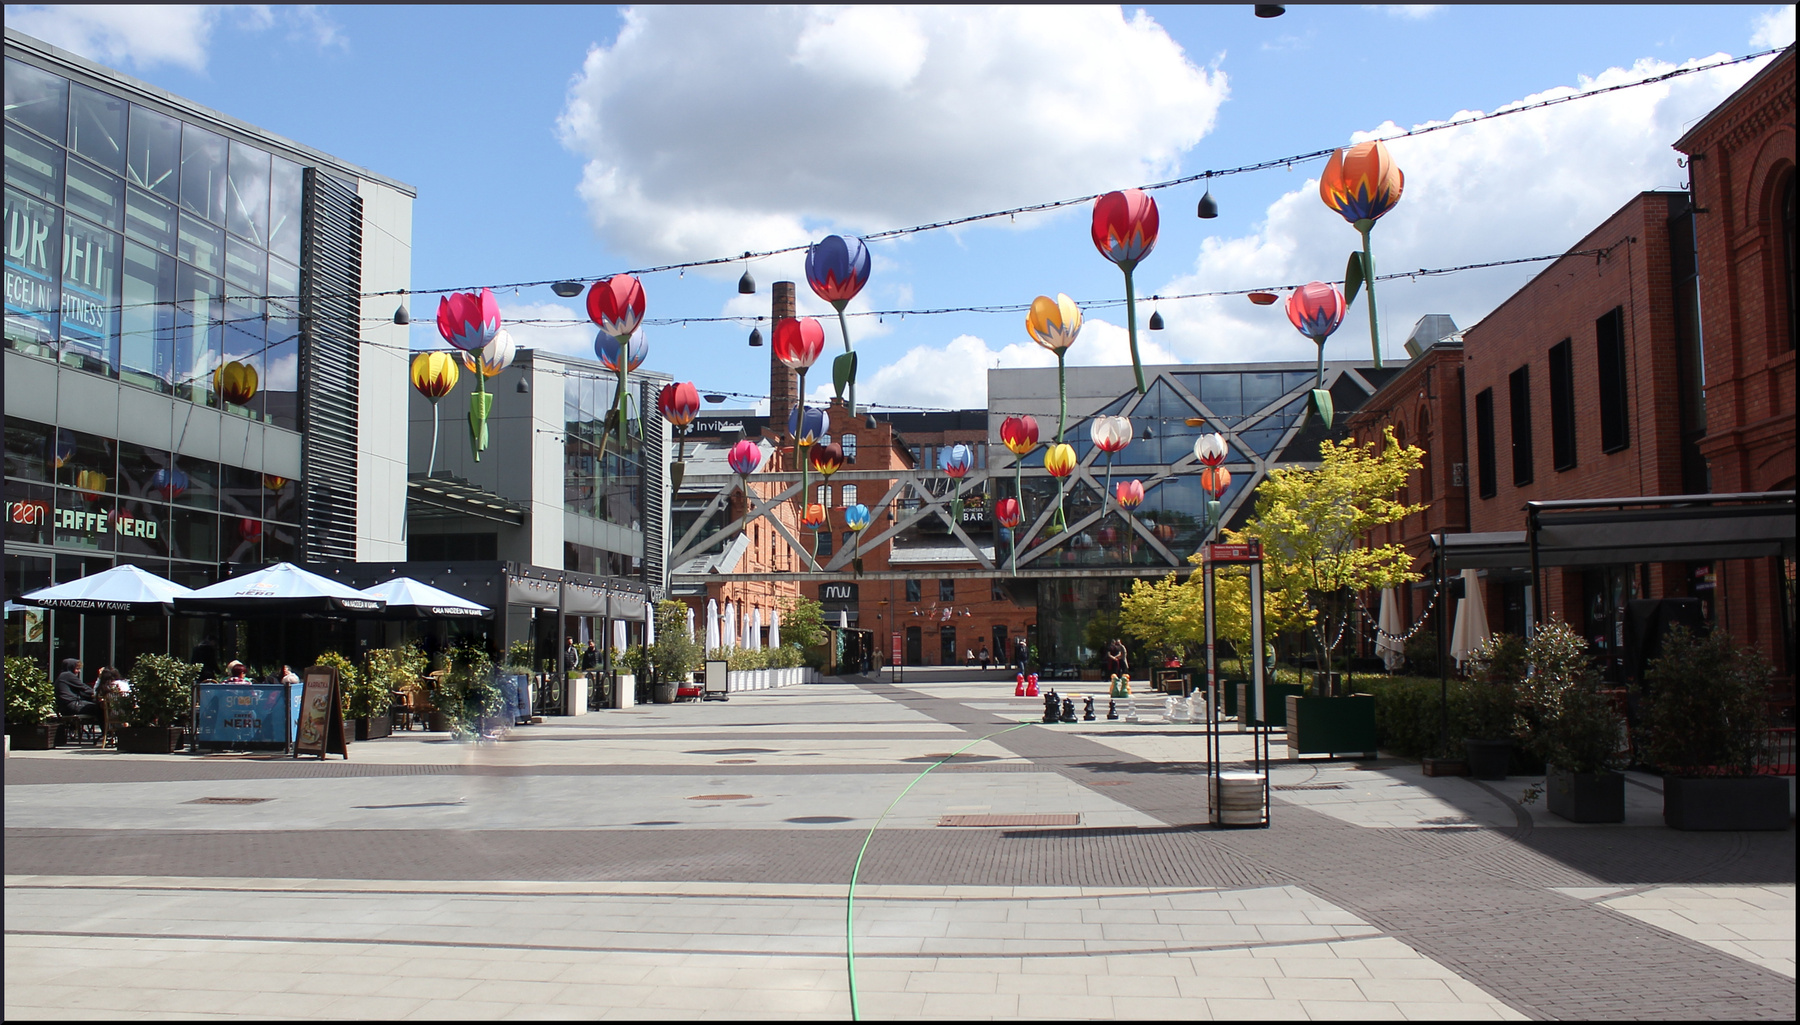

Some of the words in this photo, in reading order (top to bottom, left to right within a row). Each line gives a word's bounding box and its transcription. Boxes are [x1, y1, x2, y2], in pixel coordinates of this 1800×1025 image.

[61, 292, 103, 328] FITNESS
[4, 500, 45, 526] reen
[963, 513, 984, 521] BAR
[116, 516, 157, 539] NERO
[38, 599, 58, 607] CAŁA
[59, 600, 95, 609] NADZIEJA
[106, 602, 131, 611] KAWIE
[224, 719, 261, 728] NERO
